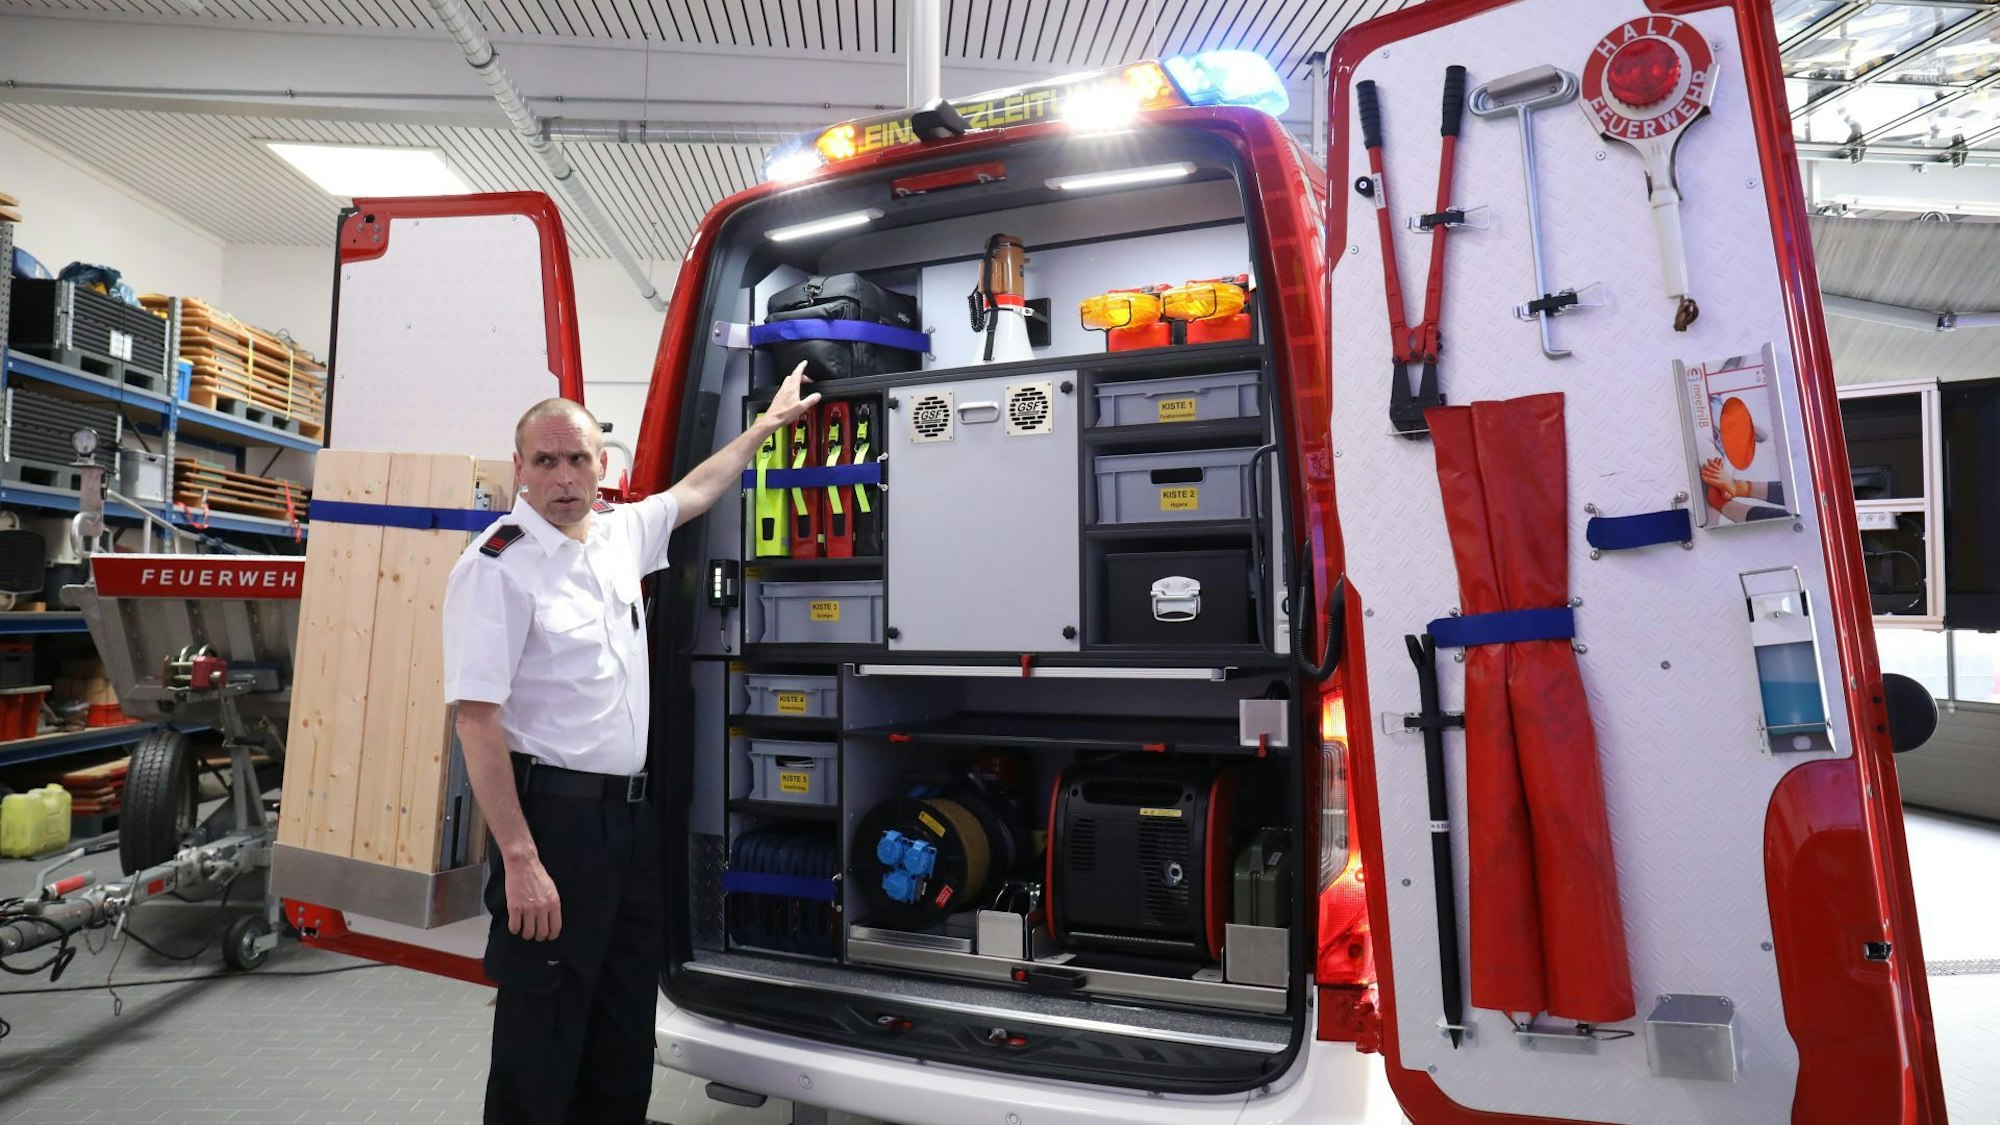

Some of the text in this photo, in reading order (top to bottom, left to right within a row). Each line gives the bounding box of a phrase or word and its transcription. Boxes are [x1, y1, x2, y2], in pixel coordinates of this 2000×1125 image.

[1596, 17, 1684, 59] HALT
[1591, 70, 1707, 138] FEUERWEHR
[1017, 400, 1041, 412] GSF
[1162, 402, 1186, 410] KISTE
[920, 409, 943, 421] GSF
[1162, 490, 1196, 499] KISTE 2
[779, 695, 799, 703] KISTE
[782, 774, 801, 783] KISTE
